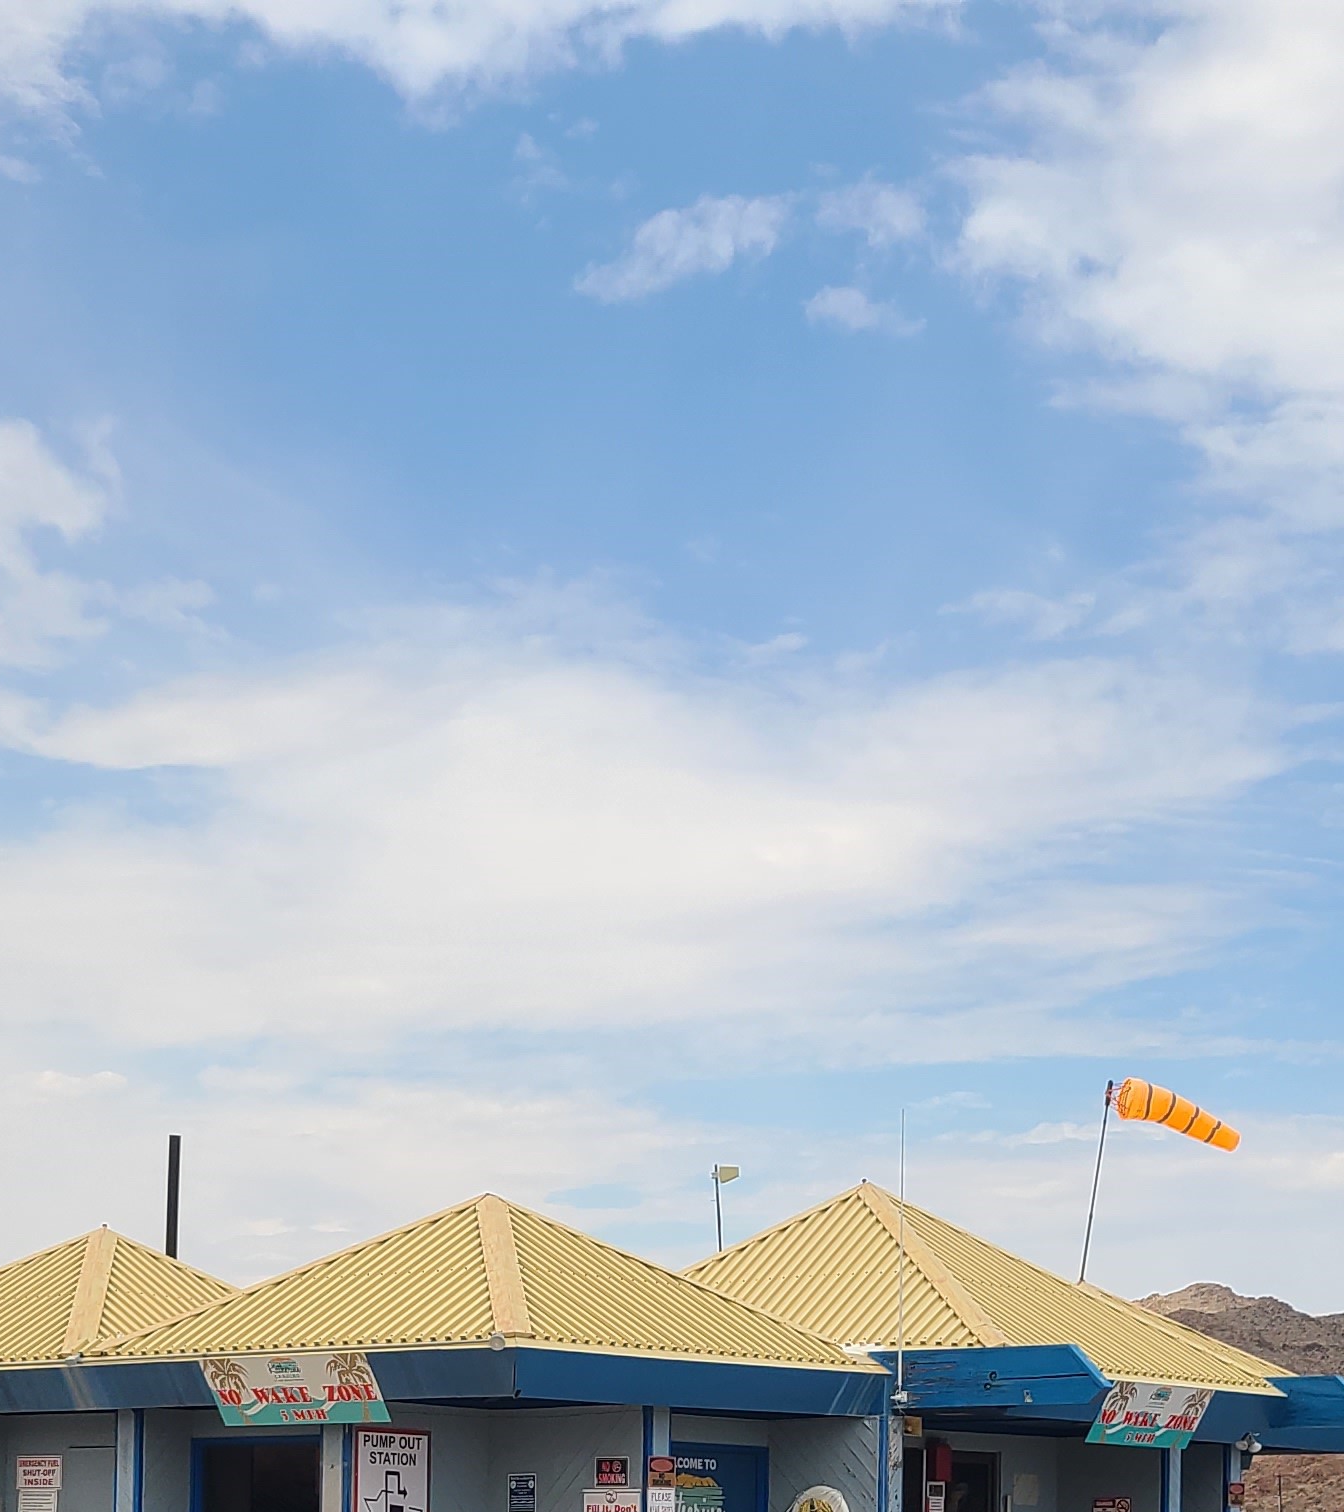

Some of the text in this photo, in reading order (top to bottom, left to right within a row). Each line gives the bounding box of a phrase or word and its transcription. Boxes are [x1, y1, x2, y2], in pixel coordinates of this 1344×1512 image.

[216, 1384, 377, 1406] NO WAKE ZONE
[293, 1409, 328, 1421] MPH
[1099, 1409, 1116, 1424] NO
[1164, 1415, 1199, 1431] ZONE
[363, 1434, 423, 1450] PUMP OUT
[369, 1451, 417, 1466] STATION
[675, 1457, 704, 1470] COME
[704, 1459, 716, 1470] TO
[598, 1473, 625, 1484] SMOKING
[614, 1504, 637, 1512] Don't
